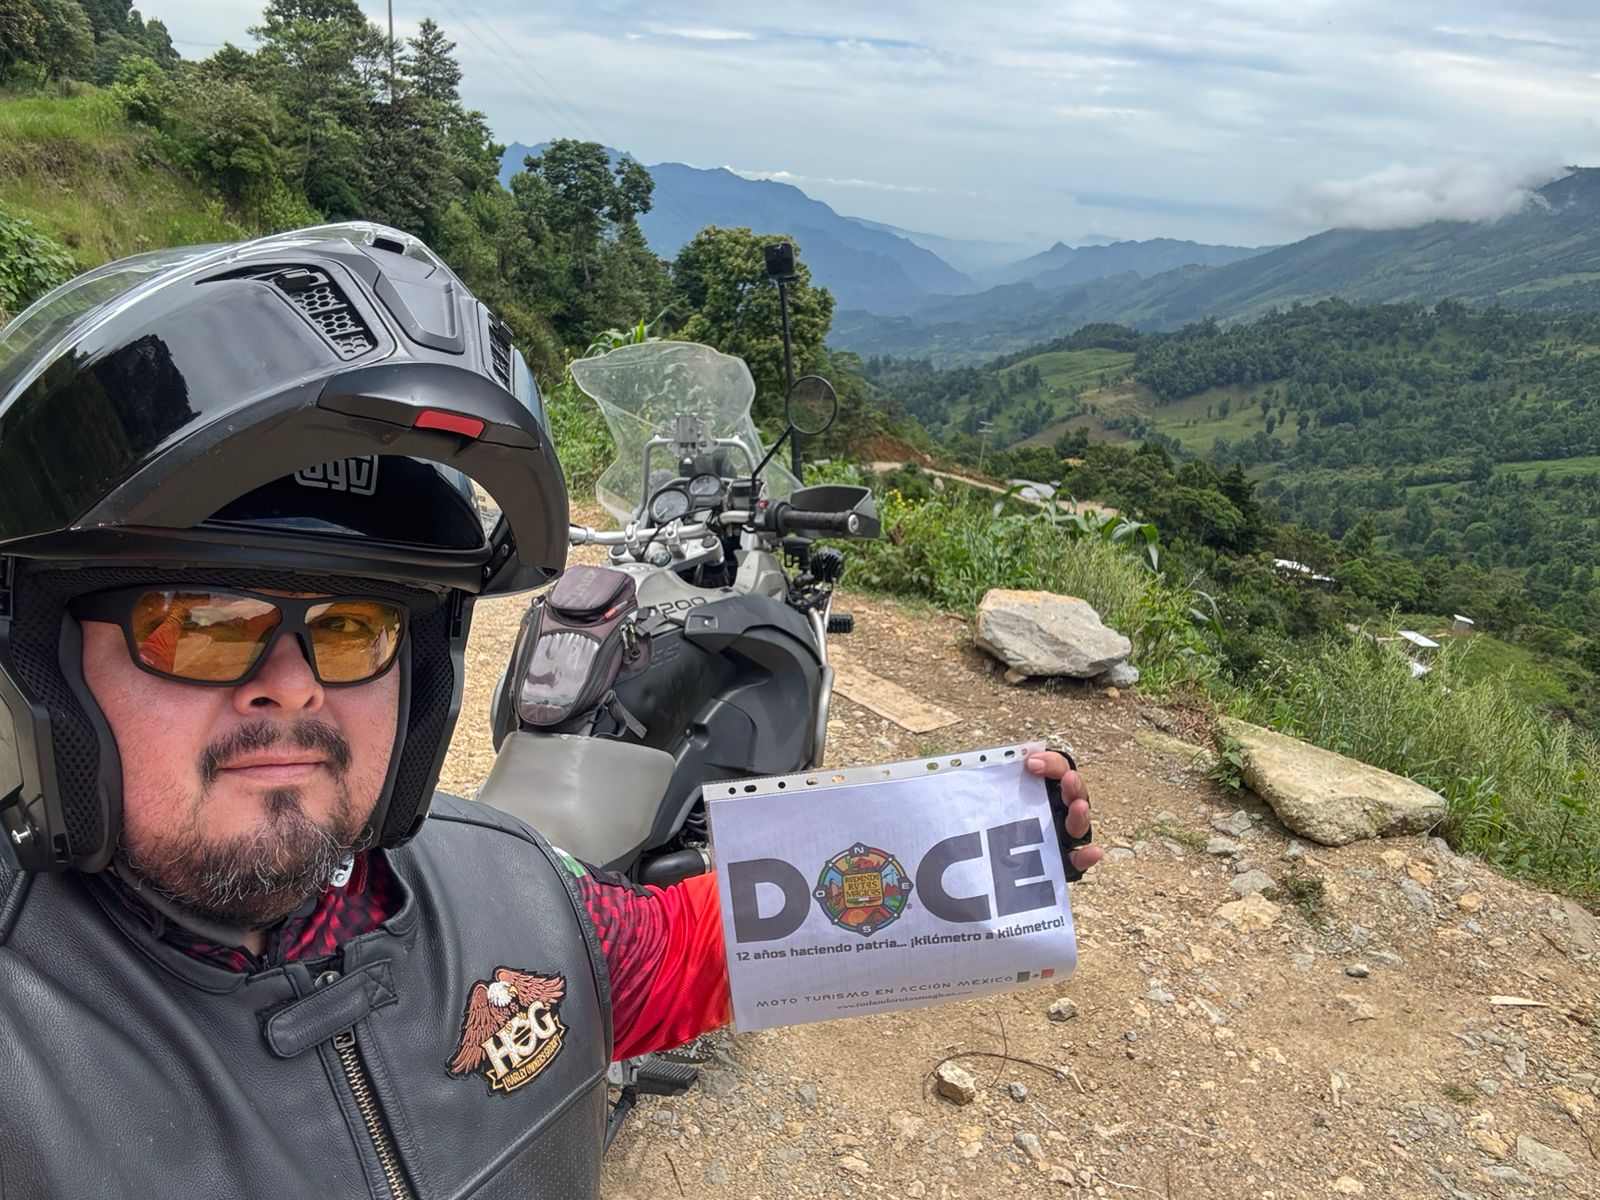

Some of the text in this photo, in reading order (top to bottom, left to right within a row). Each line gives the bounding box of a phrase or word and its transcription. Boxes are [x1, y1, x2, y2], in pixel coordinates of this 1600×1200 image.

[736, 915, 1065, 962] 12 años haciendo patria... ¡kilómetro a kilómetro!
[862, 925, 872, 933] S
[756, 998, 798, 1008] MOTO
[804, 990, 870, 1002] TURISMO
[875, 987, 894, 996] EN
[504, 1067, 528, 1087] HARLEY
